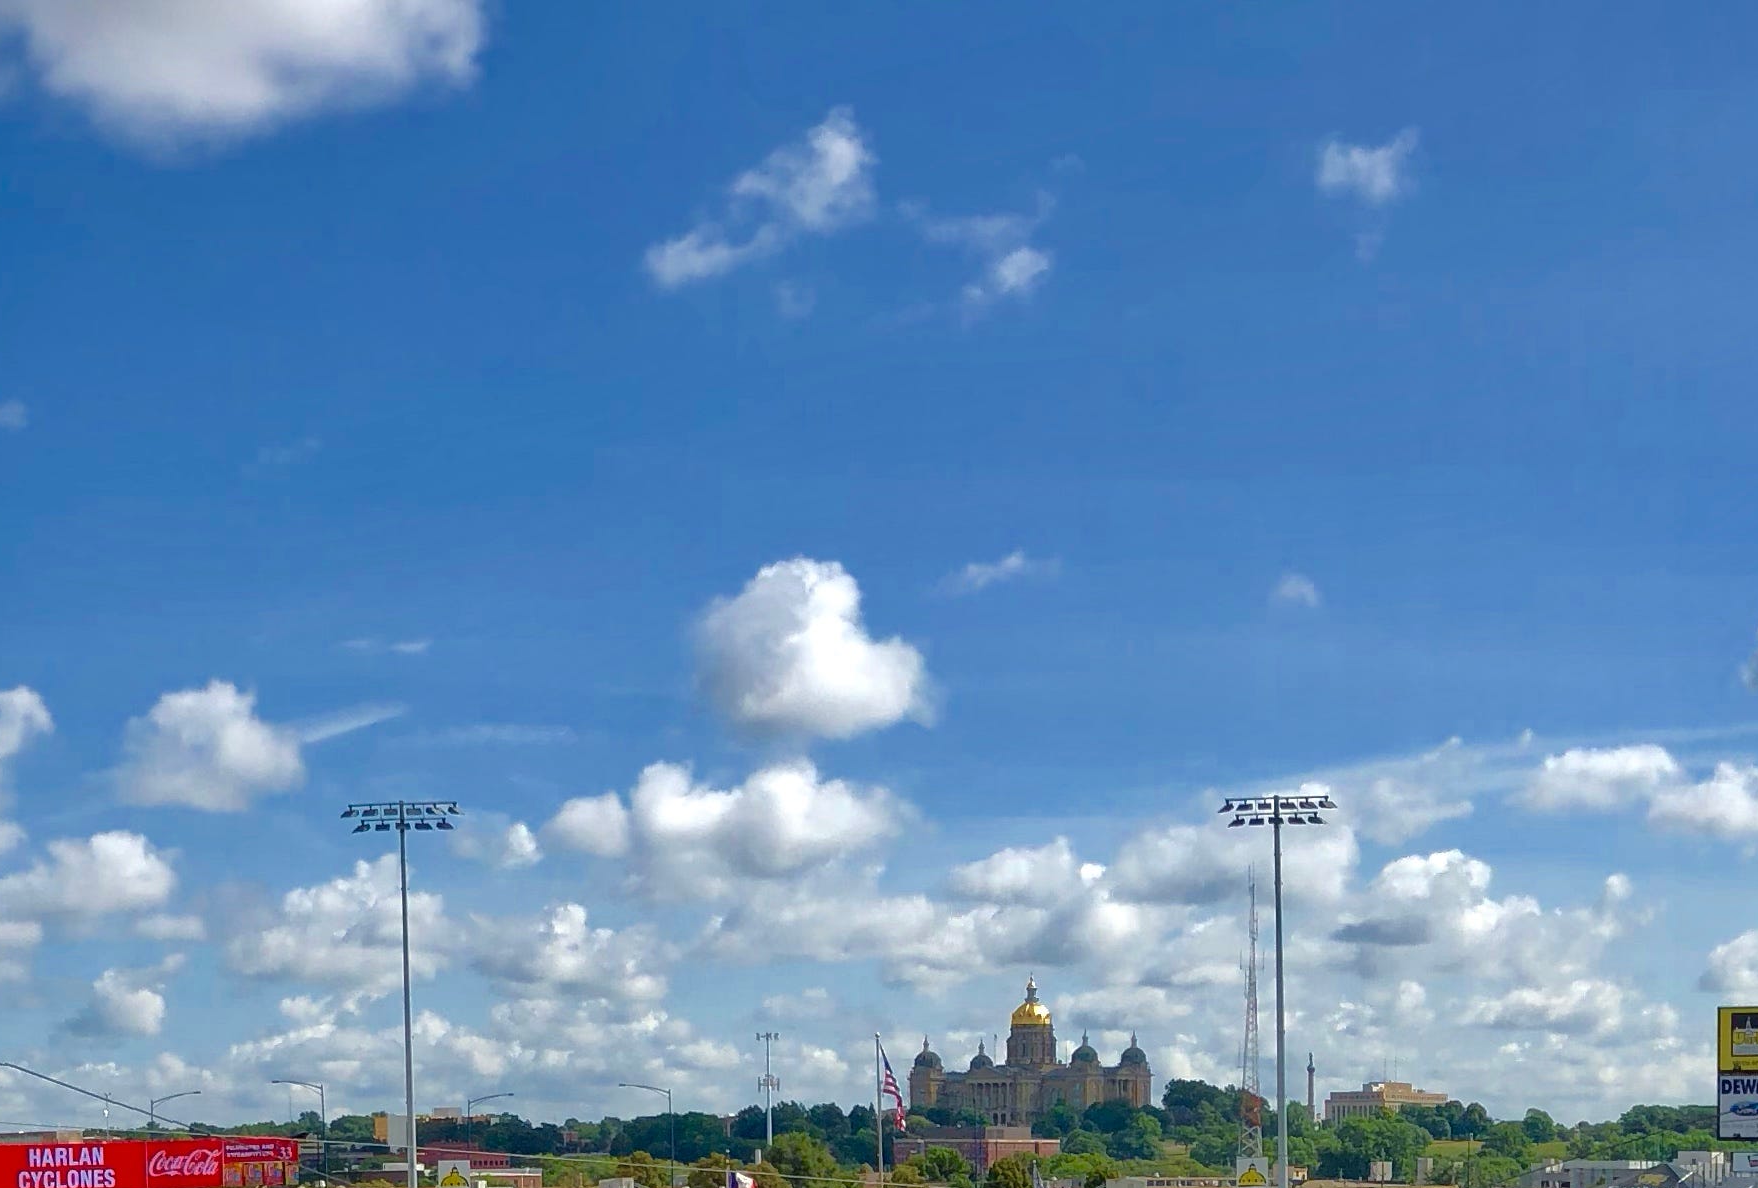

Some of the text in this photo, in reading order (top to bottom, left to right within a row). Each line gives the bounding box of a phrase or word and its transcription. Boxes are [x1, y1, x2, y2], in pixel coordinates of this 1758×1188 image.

[29, 1147, 104, 1168] HARLAN
[149, 1150, 220, 1177] Coca-Cola
[279, 1147, 293, 1159] 33
